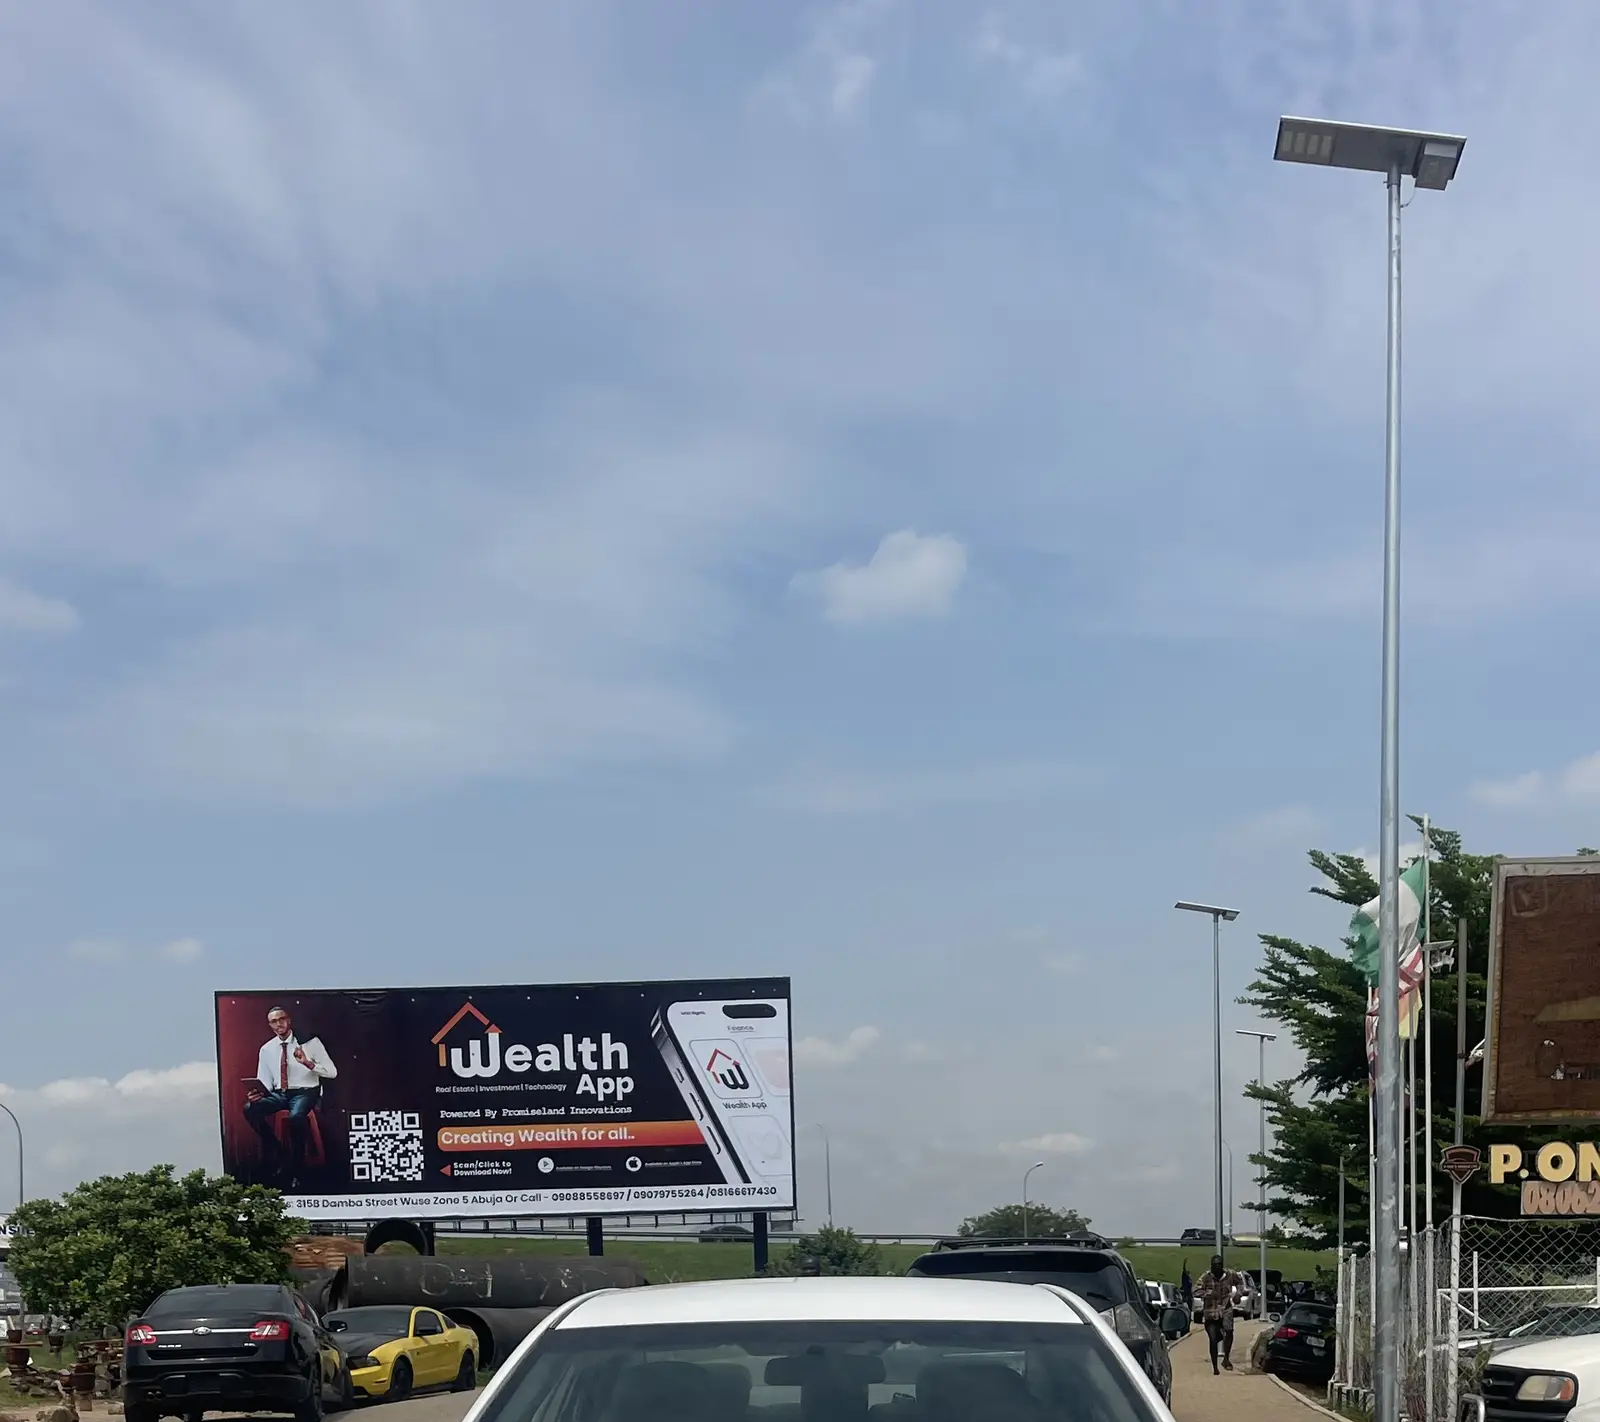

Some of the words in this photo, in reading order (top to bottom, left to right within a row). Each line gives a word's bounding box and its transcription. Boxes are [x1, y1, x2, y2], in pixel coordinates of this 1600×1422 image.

[450, 1032, 629, 1078] Wealth
[452, 1085, 475, 1093] Estate
[479, 1084, 520, 1092] Investment
[525, 1083, 567, 1092] Technology
[575, 1073, 635, 1101] App
[440, 1109, 481, 1118] Powered
[484, 1108, 497, 1119] By
[501, 1106, 565, 1117] Promiseland
[569, 1105, 633, 1115] Innovations
[440, 1129, 515, 1147] Creating
[518, 1128, 578, 1142] Wealth
[581, 1127, 604, 1141] for
[453, 1159, 501, 1169] Scan/Click
[502, 1160, 512, 1168] to
[453, 1168, 492, 1177] Download
[492, 1167, 512, 1176] Now!
[296, 1199, 320, 1208] 315B
[321, 1198, 363, 1208] Damba
[365, 1197, 398, 1207] Street
[400, 1197, 431, 1206] Wuse
[433, 1196, 460, 1205] Zone
[462, 1195, 469, 1204] 5
[471, 1194, 503, 1206] Abuja
[505, 1194, 518, 1203] Or
[520, 1193, 542, 1203] Call
